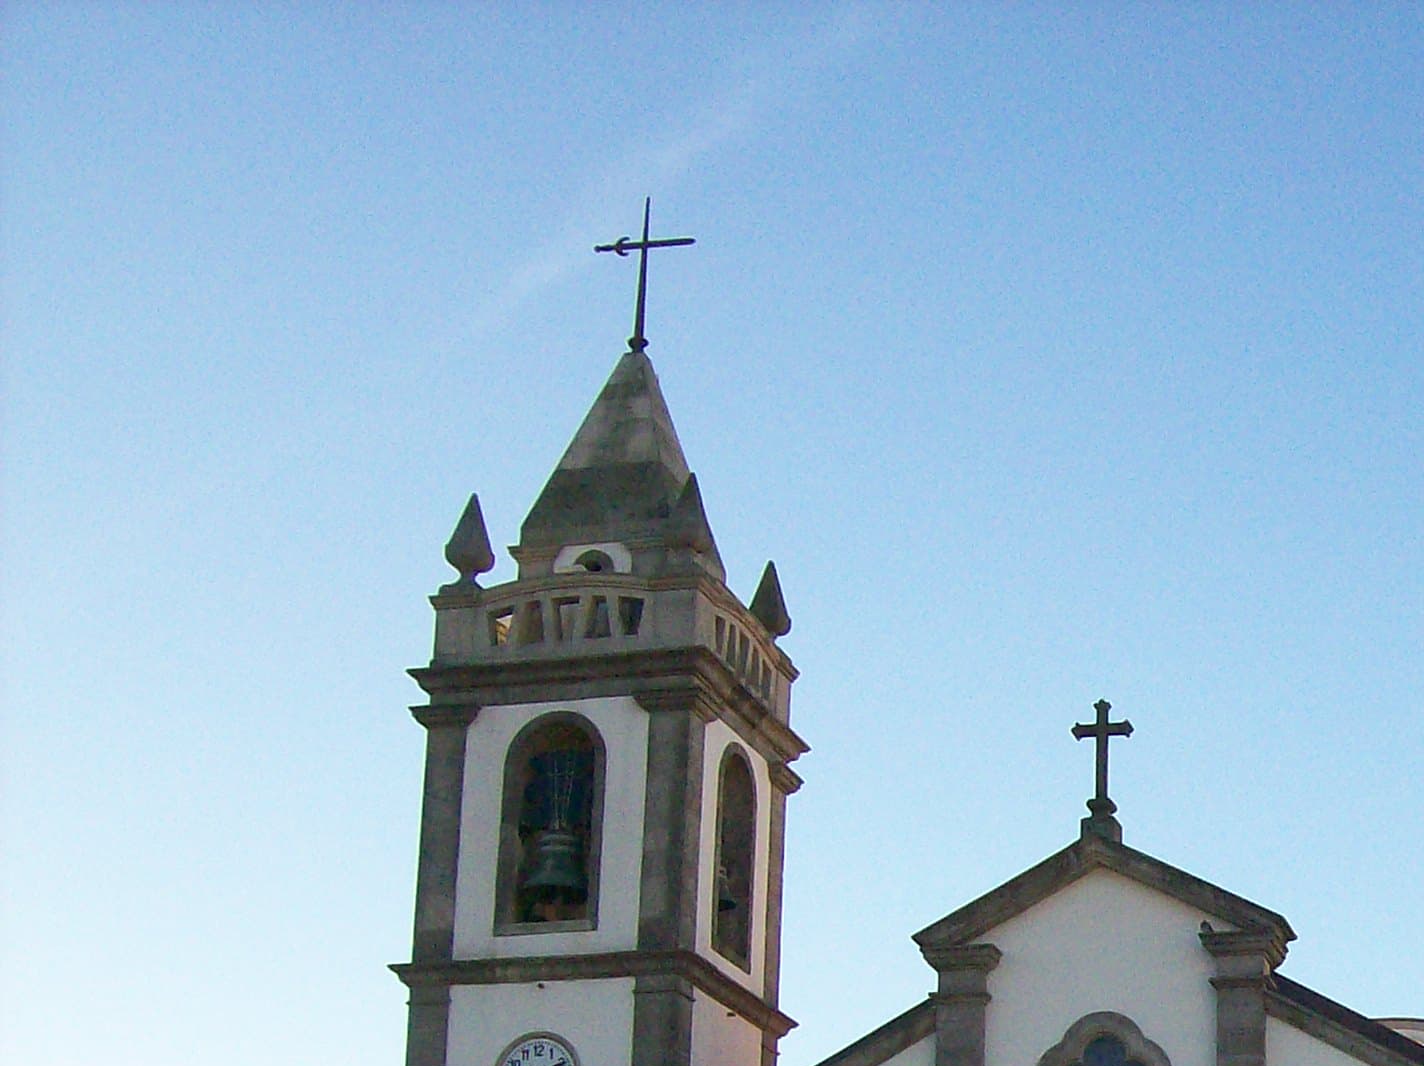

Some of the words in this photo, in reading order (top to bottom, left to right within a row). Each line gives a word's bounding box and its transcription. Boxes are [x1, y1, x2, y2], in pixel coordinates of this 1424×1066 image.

[521, 1049, 529, 1061] 11
[533, 1045, 545, 1057] 12
[550, 1048, 554, 1060] 1
